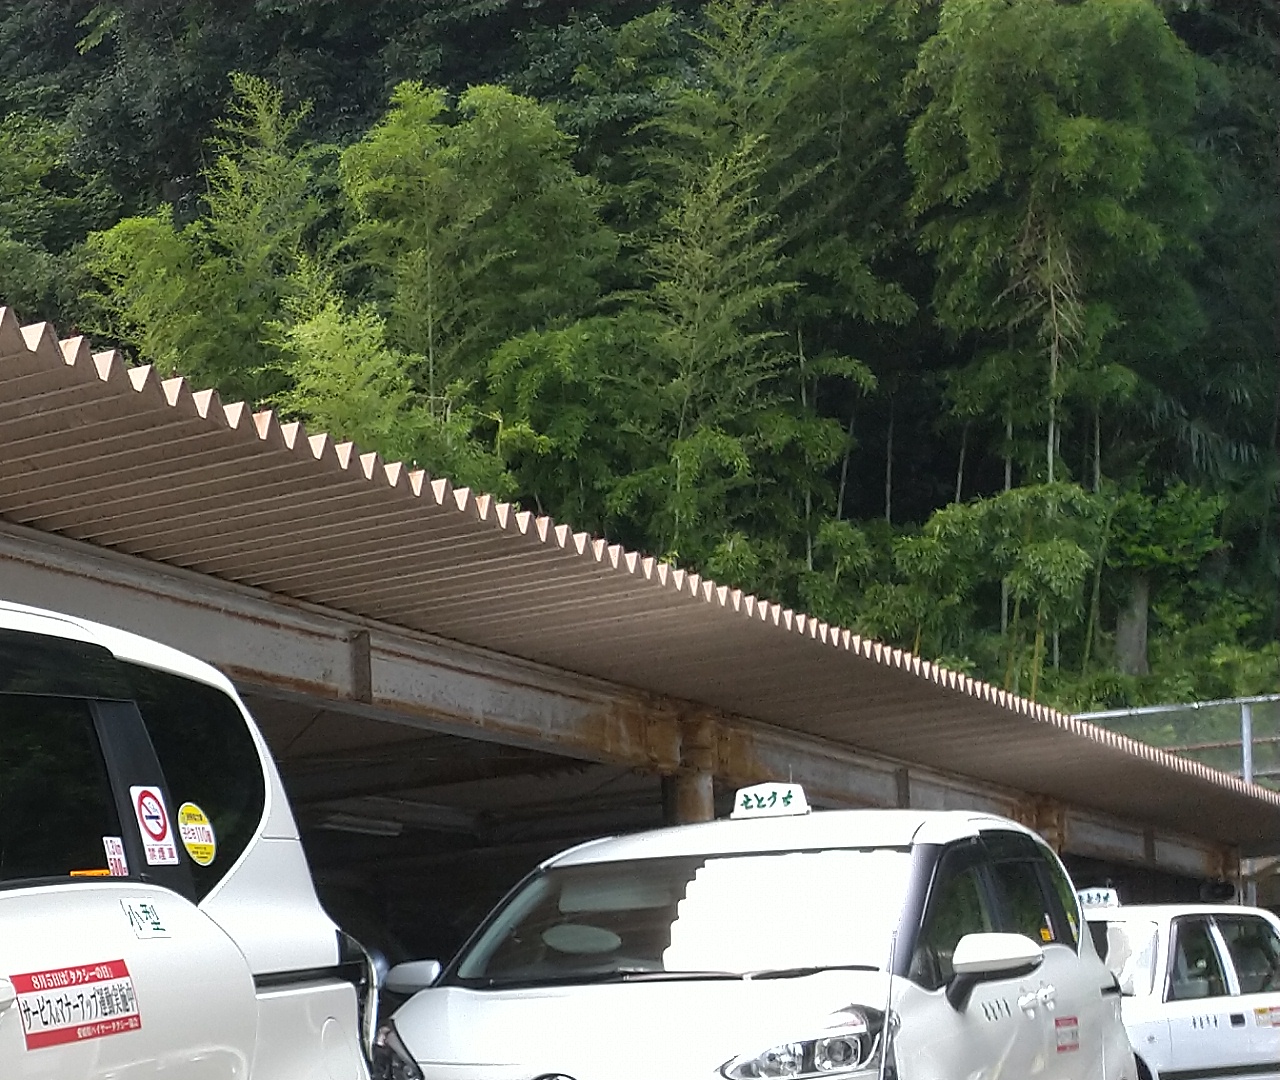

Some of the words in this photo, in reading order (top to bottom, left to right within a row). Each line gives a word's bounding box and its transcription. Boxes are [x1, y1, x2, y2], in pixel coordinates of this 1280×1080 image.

[740, 789, 793, 810] せとうち
[127, 904, 166, 931] 小型
